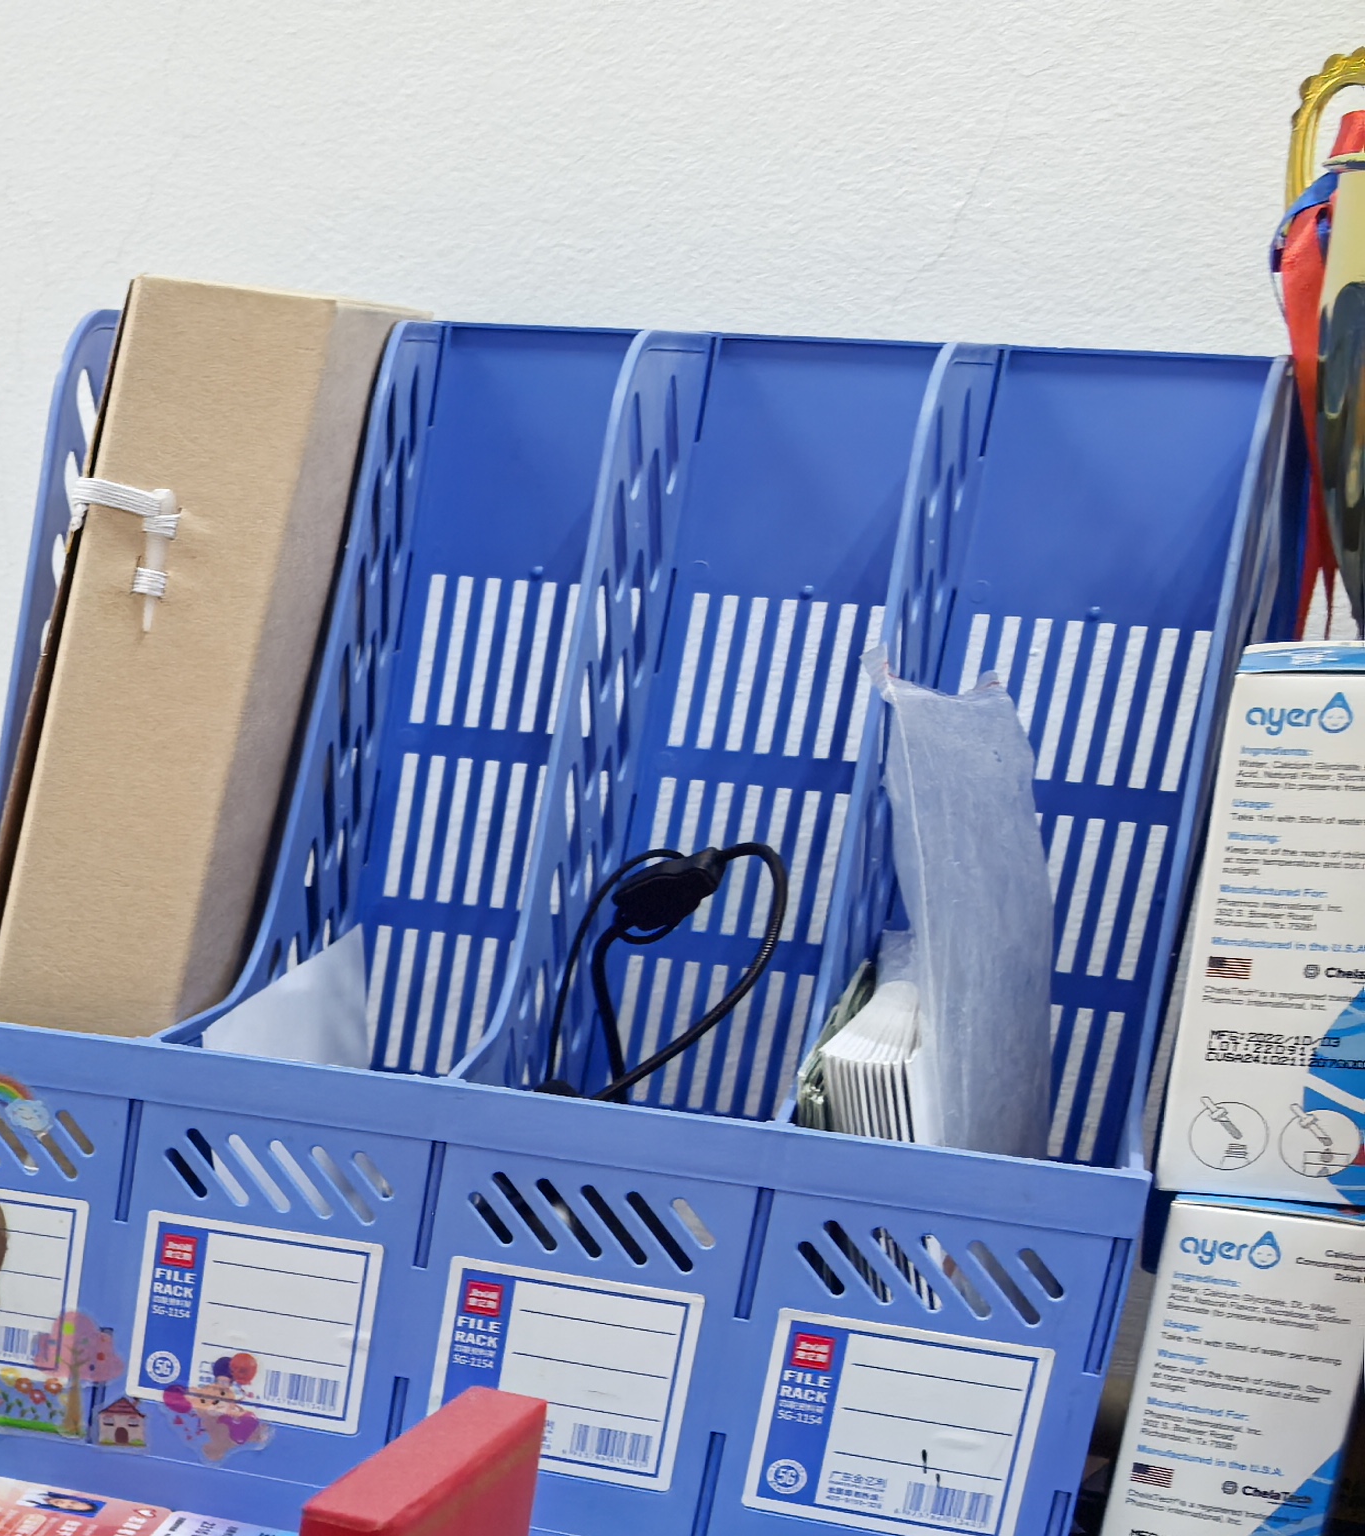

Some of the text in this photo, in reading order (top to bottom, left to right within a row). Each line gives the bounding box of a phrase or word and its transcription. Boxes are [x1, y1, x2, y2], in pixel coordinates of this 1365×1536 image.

[155, 1268, 196, 1284] FILE
[153, 1282, 194, 1299] RACK
[457, 1315, 501, 1333] FILE
[455, 1331, 498, 1348] RACK
[783, 1369, 832, 1389] FILE
[779, 1385, 827, 1403] RACK
